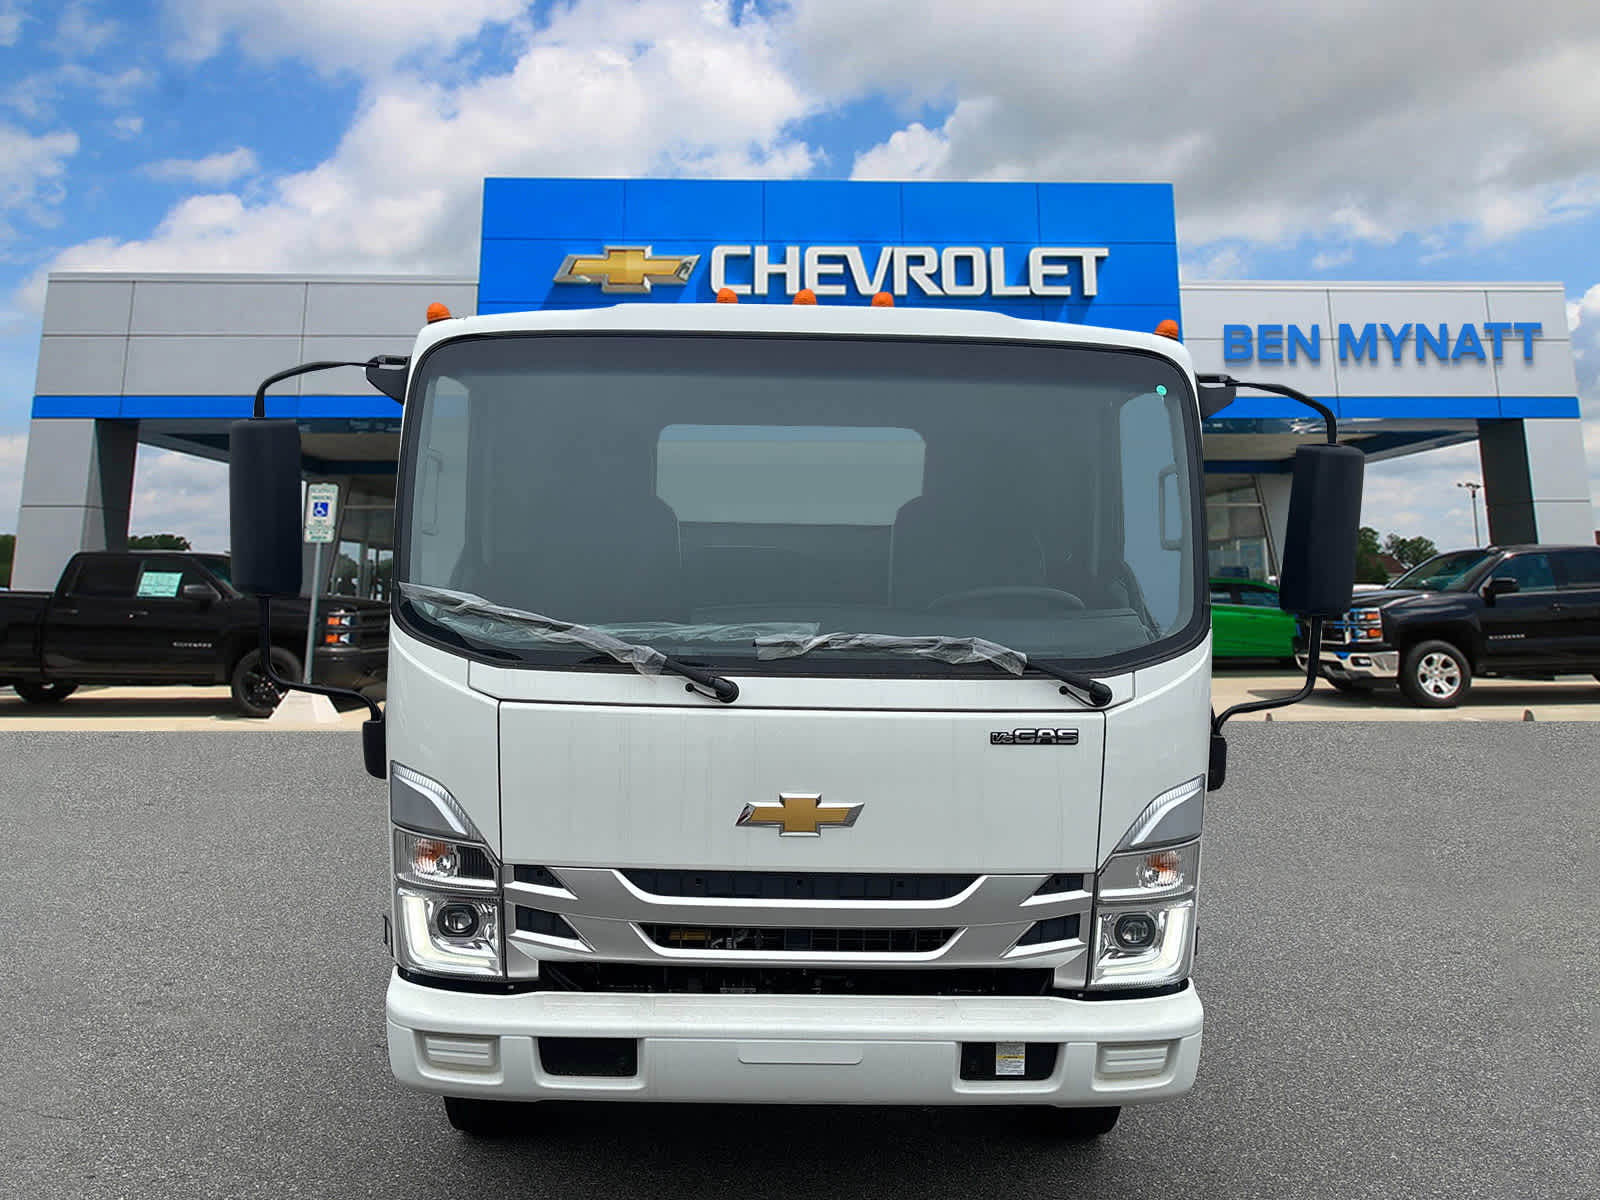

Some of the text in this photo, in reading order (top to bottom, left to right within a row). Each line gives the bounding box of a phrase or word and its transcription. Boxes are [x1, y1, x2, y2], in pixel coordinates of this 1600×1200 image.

[710, 245, 1110, 296] CHEVROLET
[1223, 322, 1543, 365] BEN MYNATT
